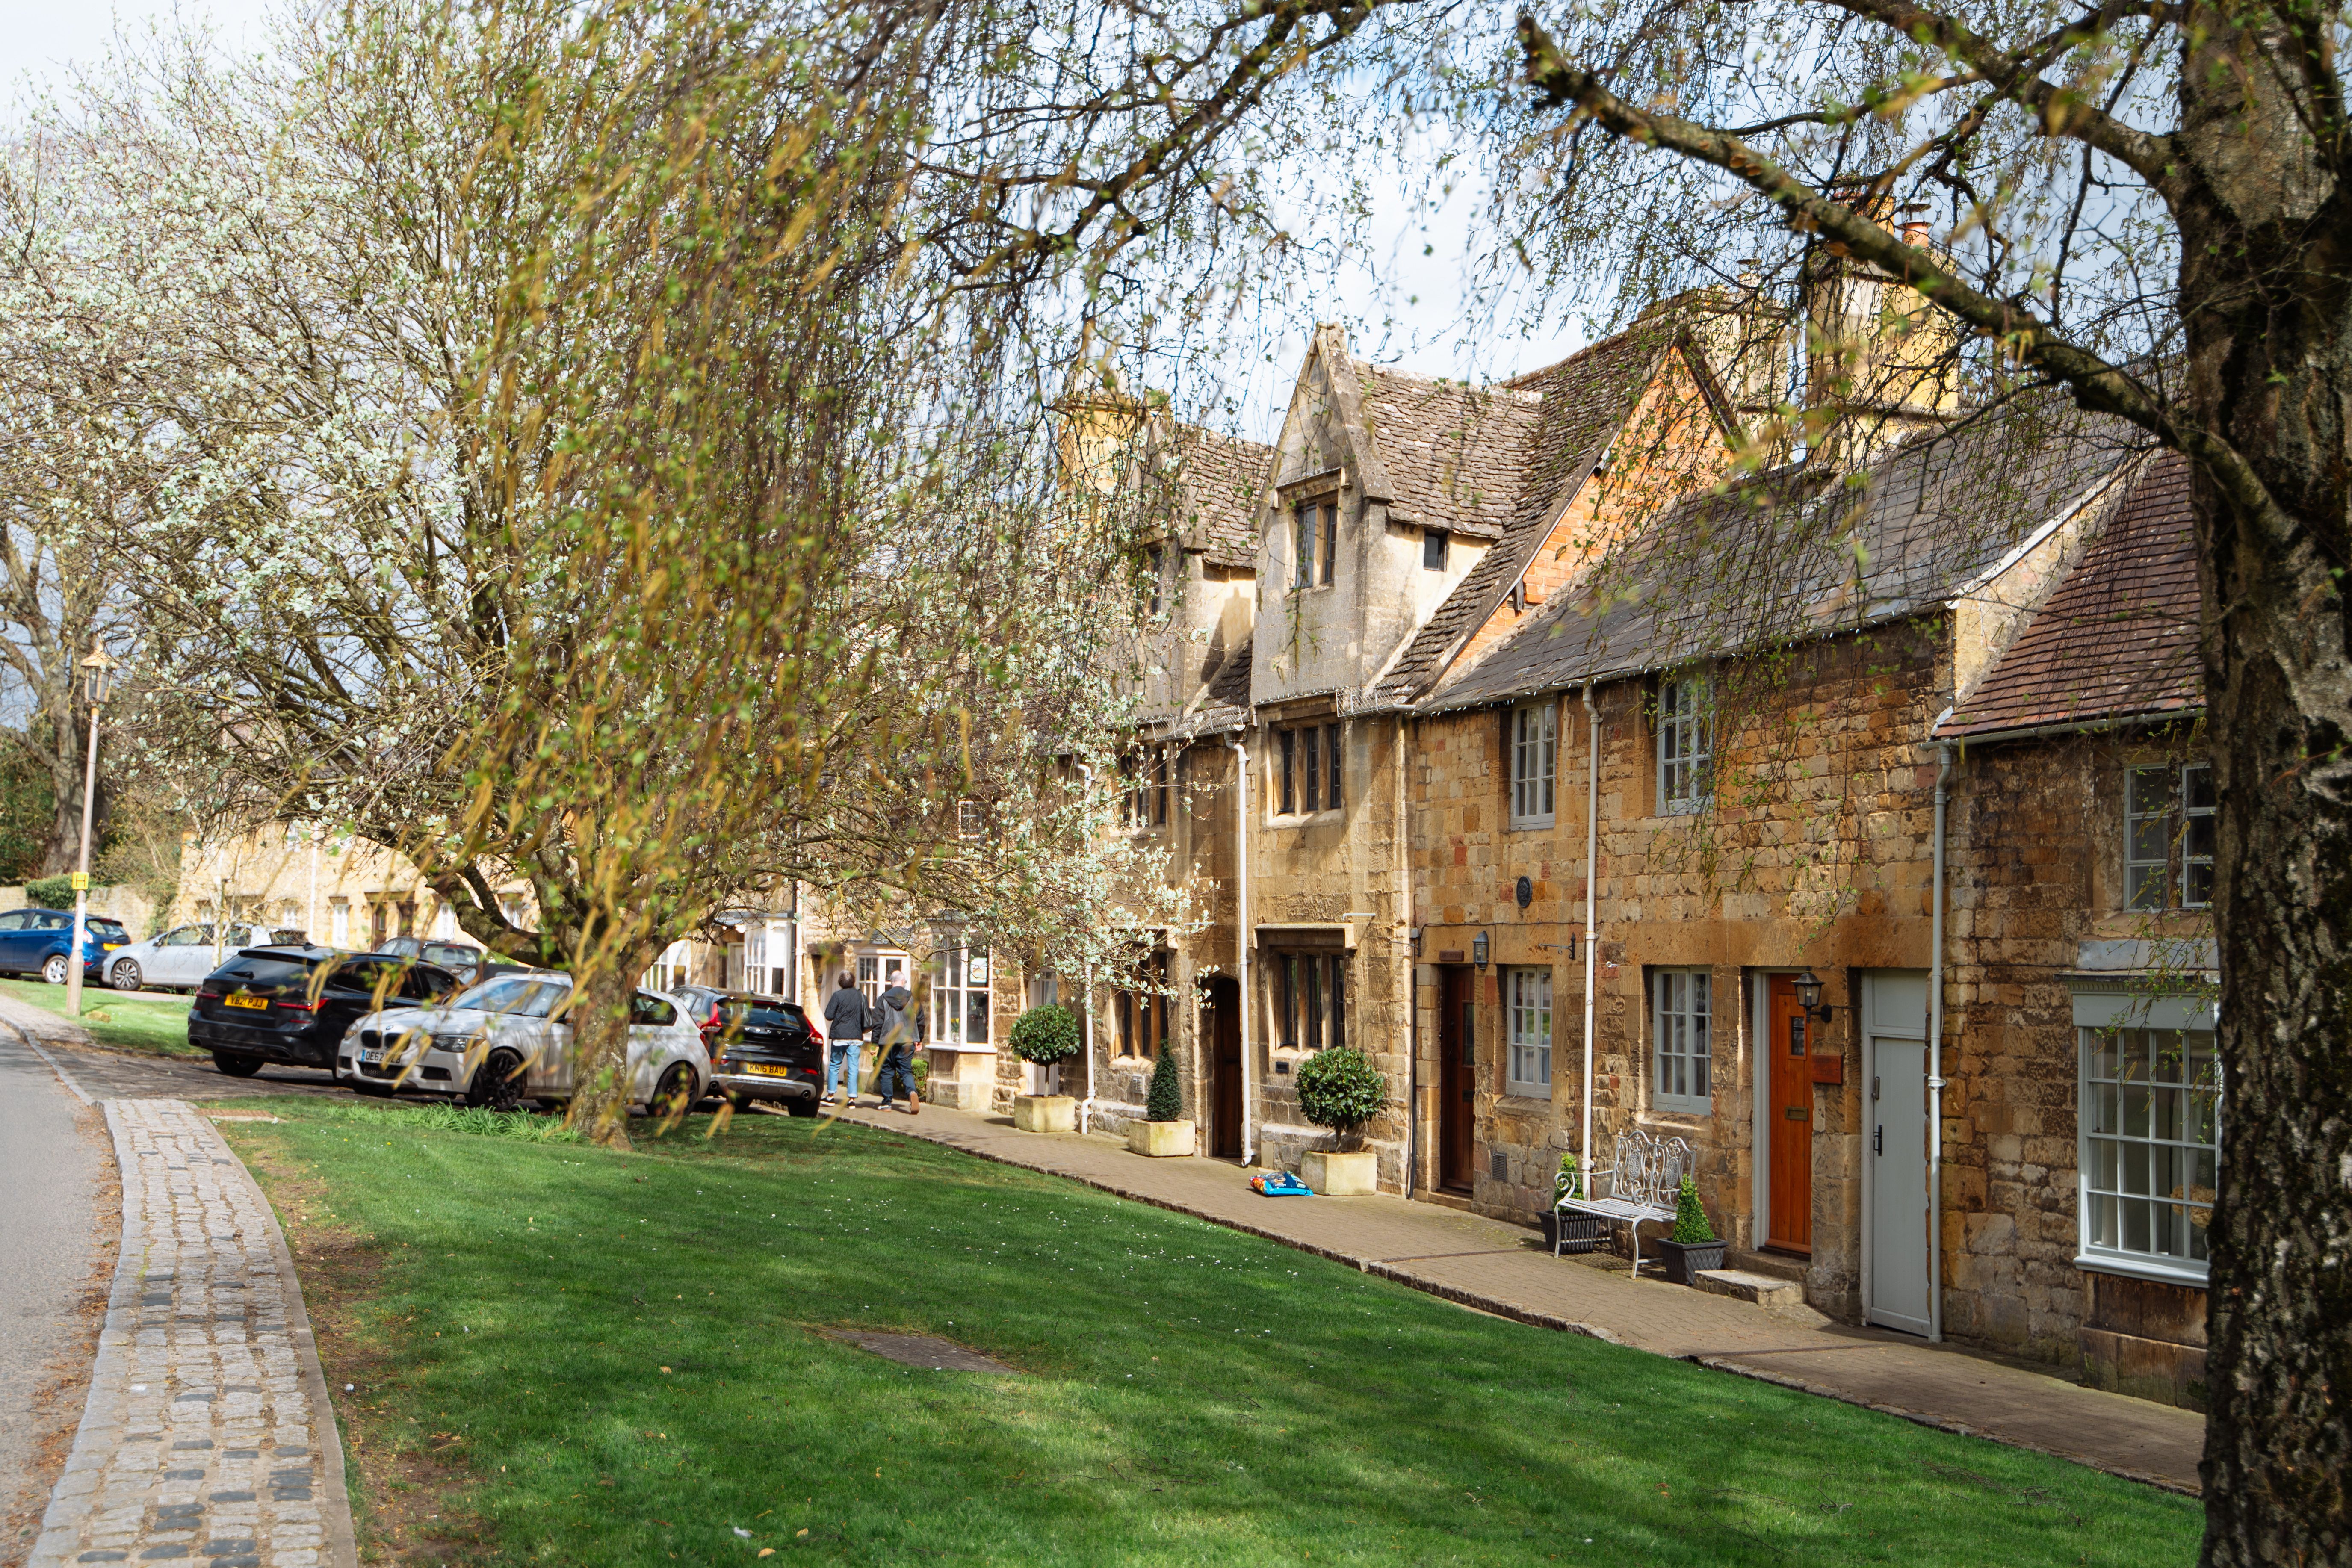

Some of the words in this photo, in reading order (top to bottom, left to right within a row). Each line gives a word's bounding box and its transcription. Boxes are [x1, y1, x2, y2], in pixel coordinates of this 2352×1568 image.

[75, 874, 86, 887] H
[231, 995, 247, 1006] YB21
[248, 997, 263, 1007] PJJ
[366, 1051, 384, 1061] OE62
[750, 1063, 767, 1072] KN16
[769, 1065, 784, 1074] BAU
